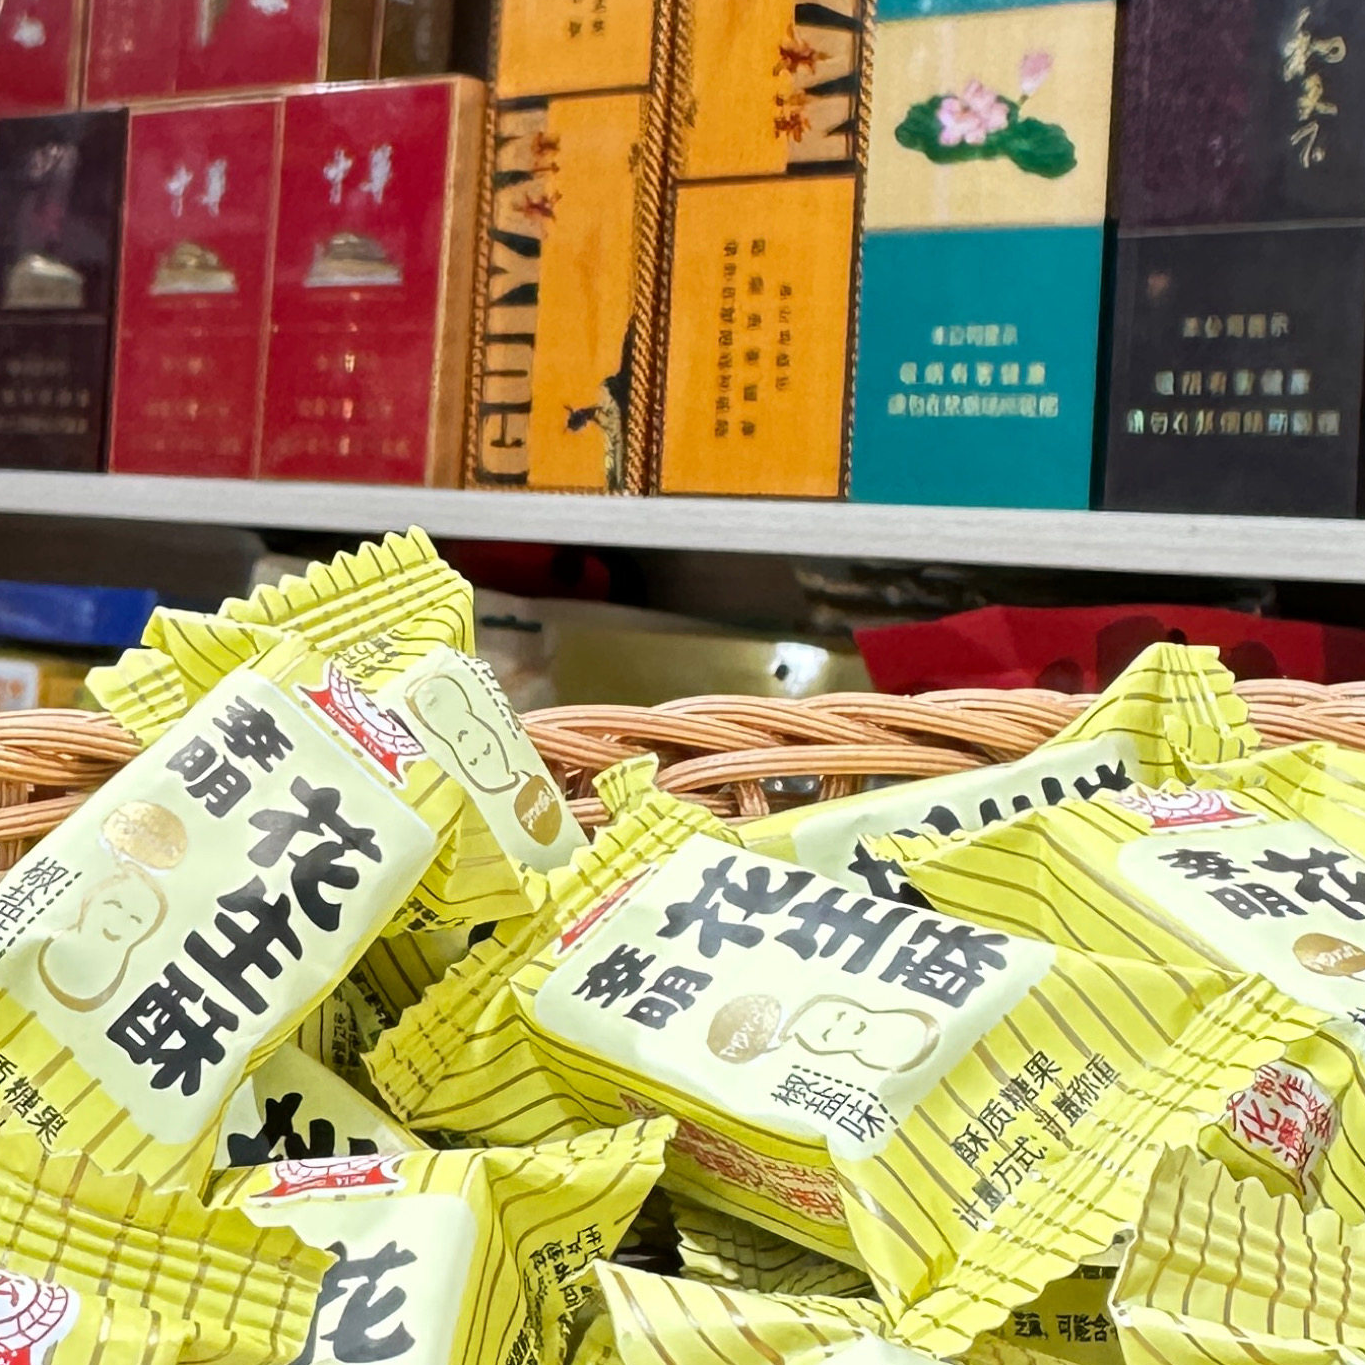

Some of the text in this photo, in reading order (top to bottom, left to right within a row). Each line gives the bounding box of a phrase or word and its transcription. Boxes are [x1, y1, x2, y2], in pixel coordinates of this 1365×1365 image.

[476, 98, 548, 485] GUIYAN
[164, 693, 294, 821] 李明
[104, 775, 385, 1100] 花生酥
[656, 855, 1011, 1011] 花生酥
[1157, 848, 1309, 921] 李明
[572, 941, 714, 1031] 李明
[771, 1069, 890, 1146] 椒盐味
[952, 1050, 1064, 1170] 酥质糖果
